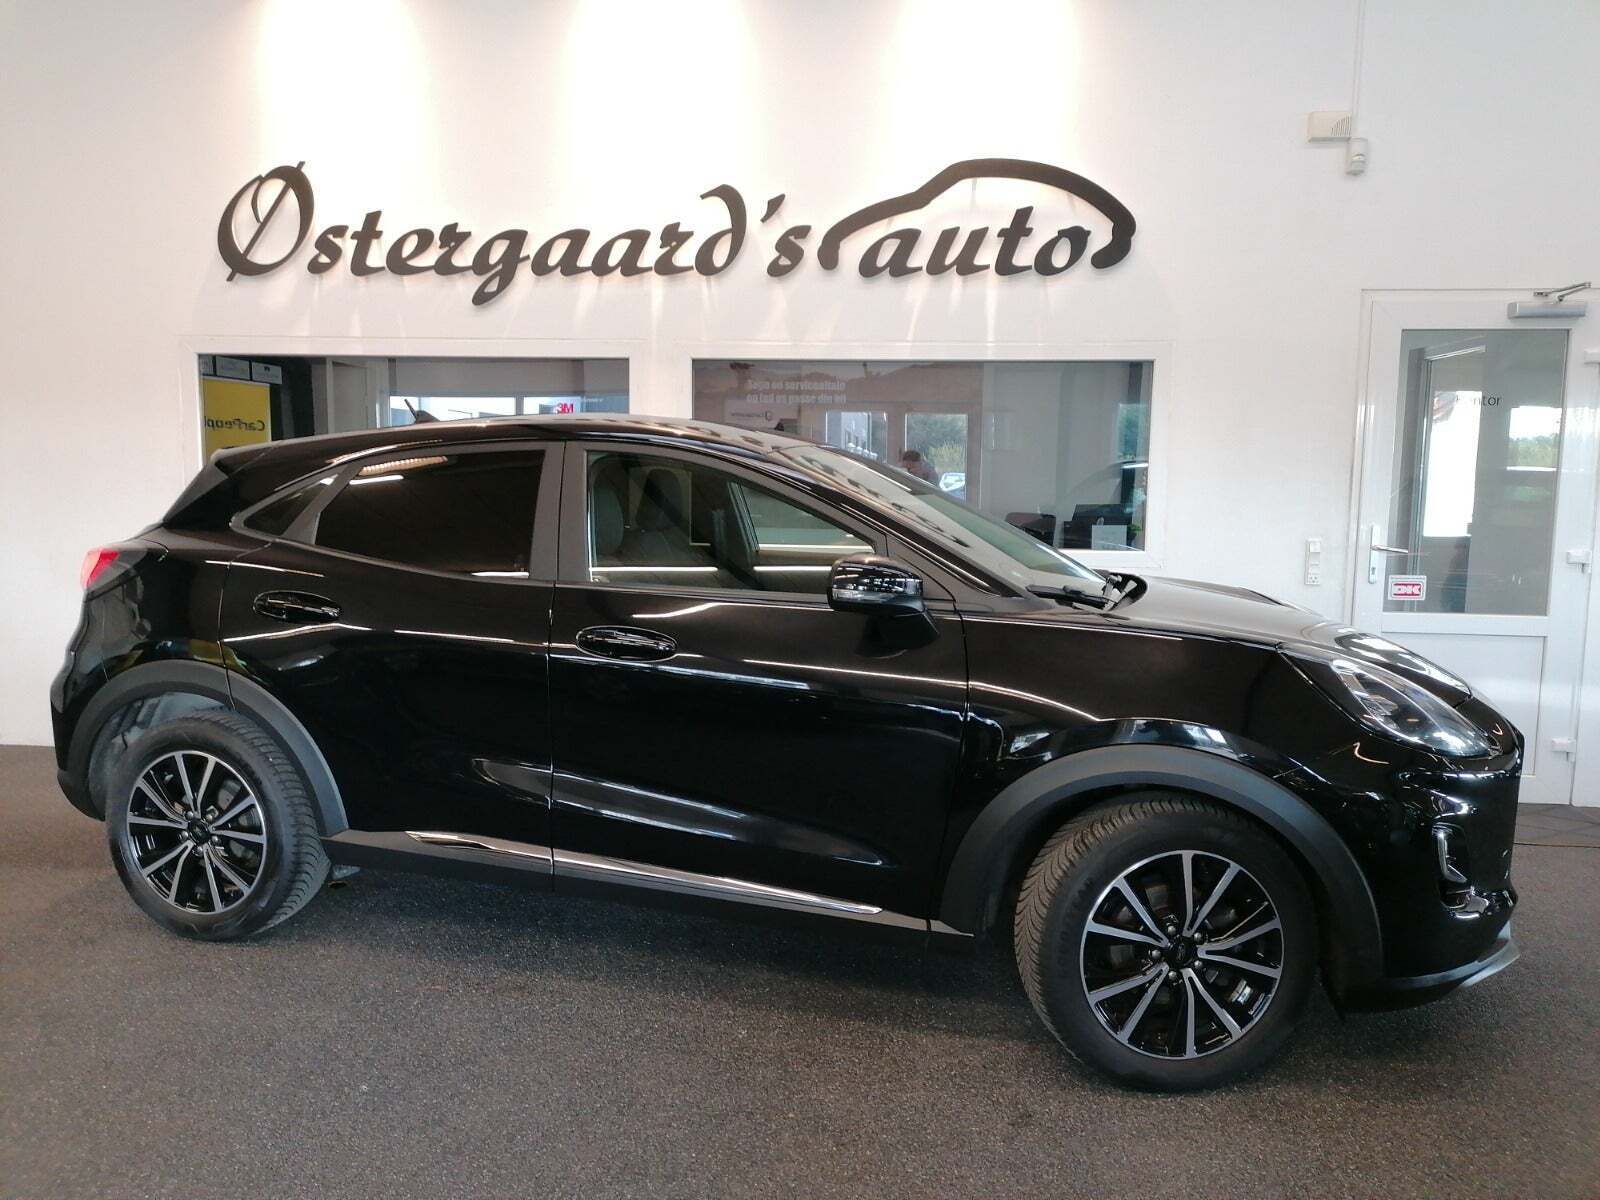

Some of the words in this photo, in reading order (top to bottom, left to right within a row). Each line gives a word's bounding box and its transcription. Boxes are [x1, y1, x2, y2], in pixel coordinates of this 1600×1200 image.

[217, 160, 812, 306] Østergaard's
[858, 205, 1092, 278] auto
[556, 402, 574, 415] 3M
